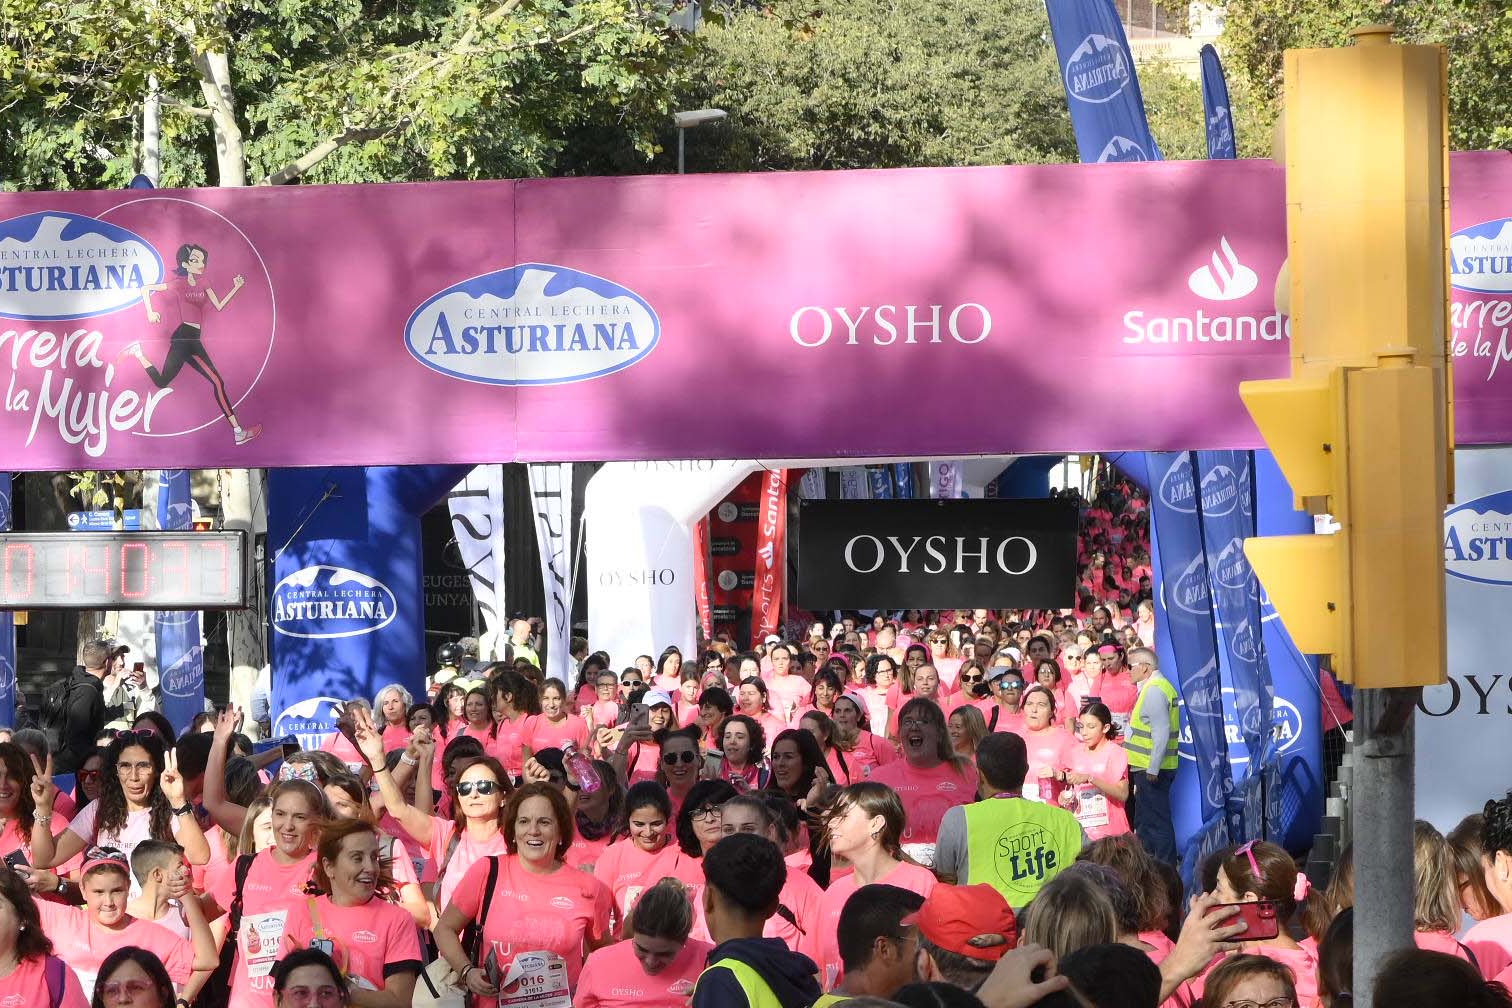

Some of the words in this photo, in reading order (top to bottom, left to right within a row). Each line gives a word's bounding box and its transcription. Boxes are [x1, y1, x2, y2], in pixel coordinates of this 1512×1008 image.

[65, 247, 140, 260] LECHERA
[463, 307, 543, 320] CENTRAL
[550, 303, 632, 318] LECHERA
[789, 302, 993, 348] OYSHO
[424, 311, 641, 356] ASTURIANA
[5, 374, 29, 411] la
[25, 364, 174, 457] Mujer
[843, 534, 1039, 576] OYSHO
[274, 594, 388, 623] ASTURIANA
[287, 590, 328, 600] CENTRAL
[333, 590, 383, 599] LECHERA
[1416, 674, 1512, 717] OY
[998, 828, 1047, 858] Sport
[1009, 846, 1057, 881] Life
[520, 974, 545, 987] 016
